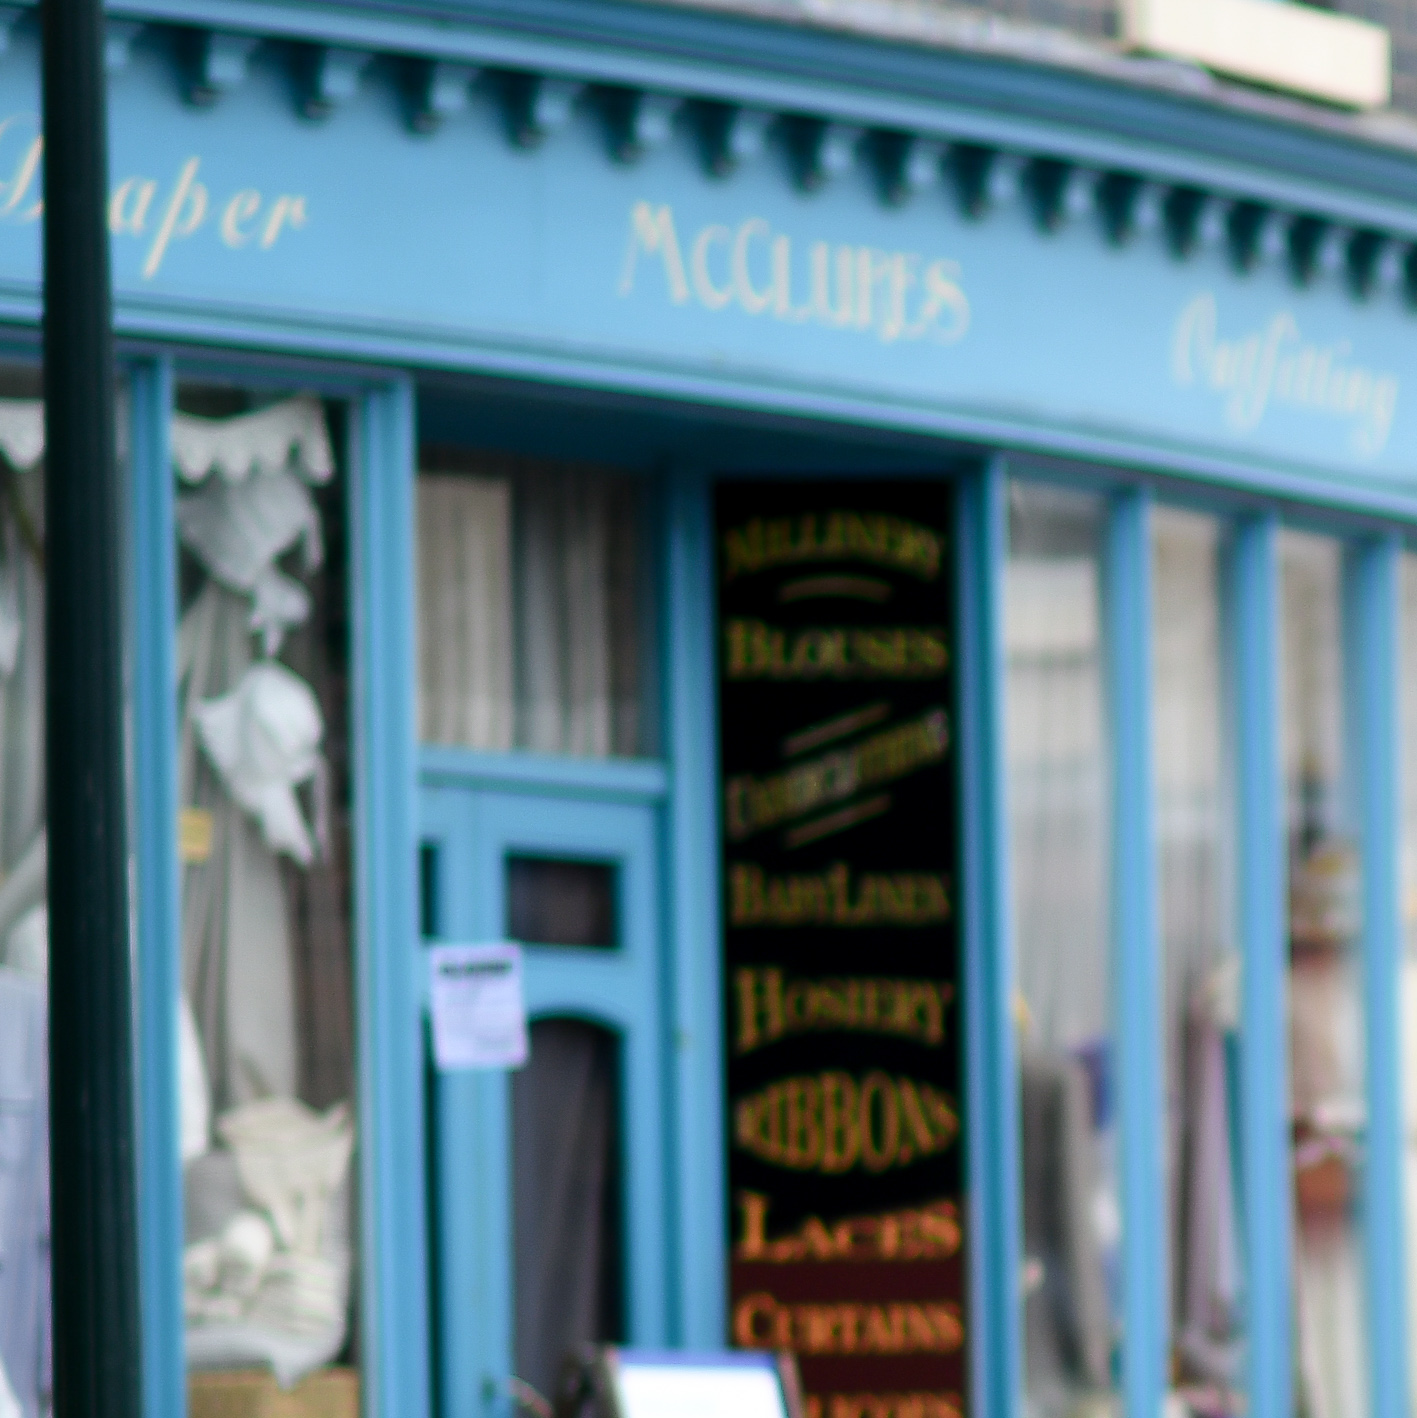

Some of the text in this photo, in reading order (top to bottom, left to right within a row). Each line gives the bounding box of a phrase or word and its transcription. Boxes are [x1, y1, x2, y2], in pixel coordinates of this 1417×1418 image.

[0, 113, 308, 280] Daper
[735, 967, 955, 1052] HOSIERY
[737, 1070, 959, 1171] RIBBONS
[737, 1191, 962, 1261] LACES
[735, 1293, 964, 1355] CURTAINS
